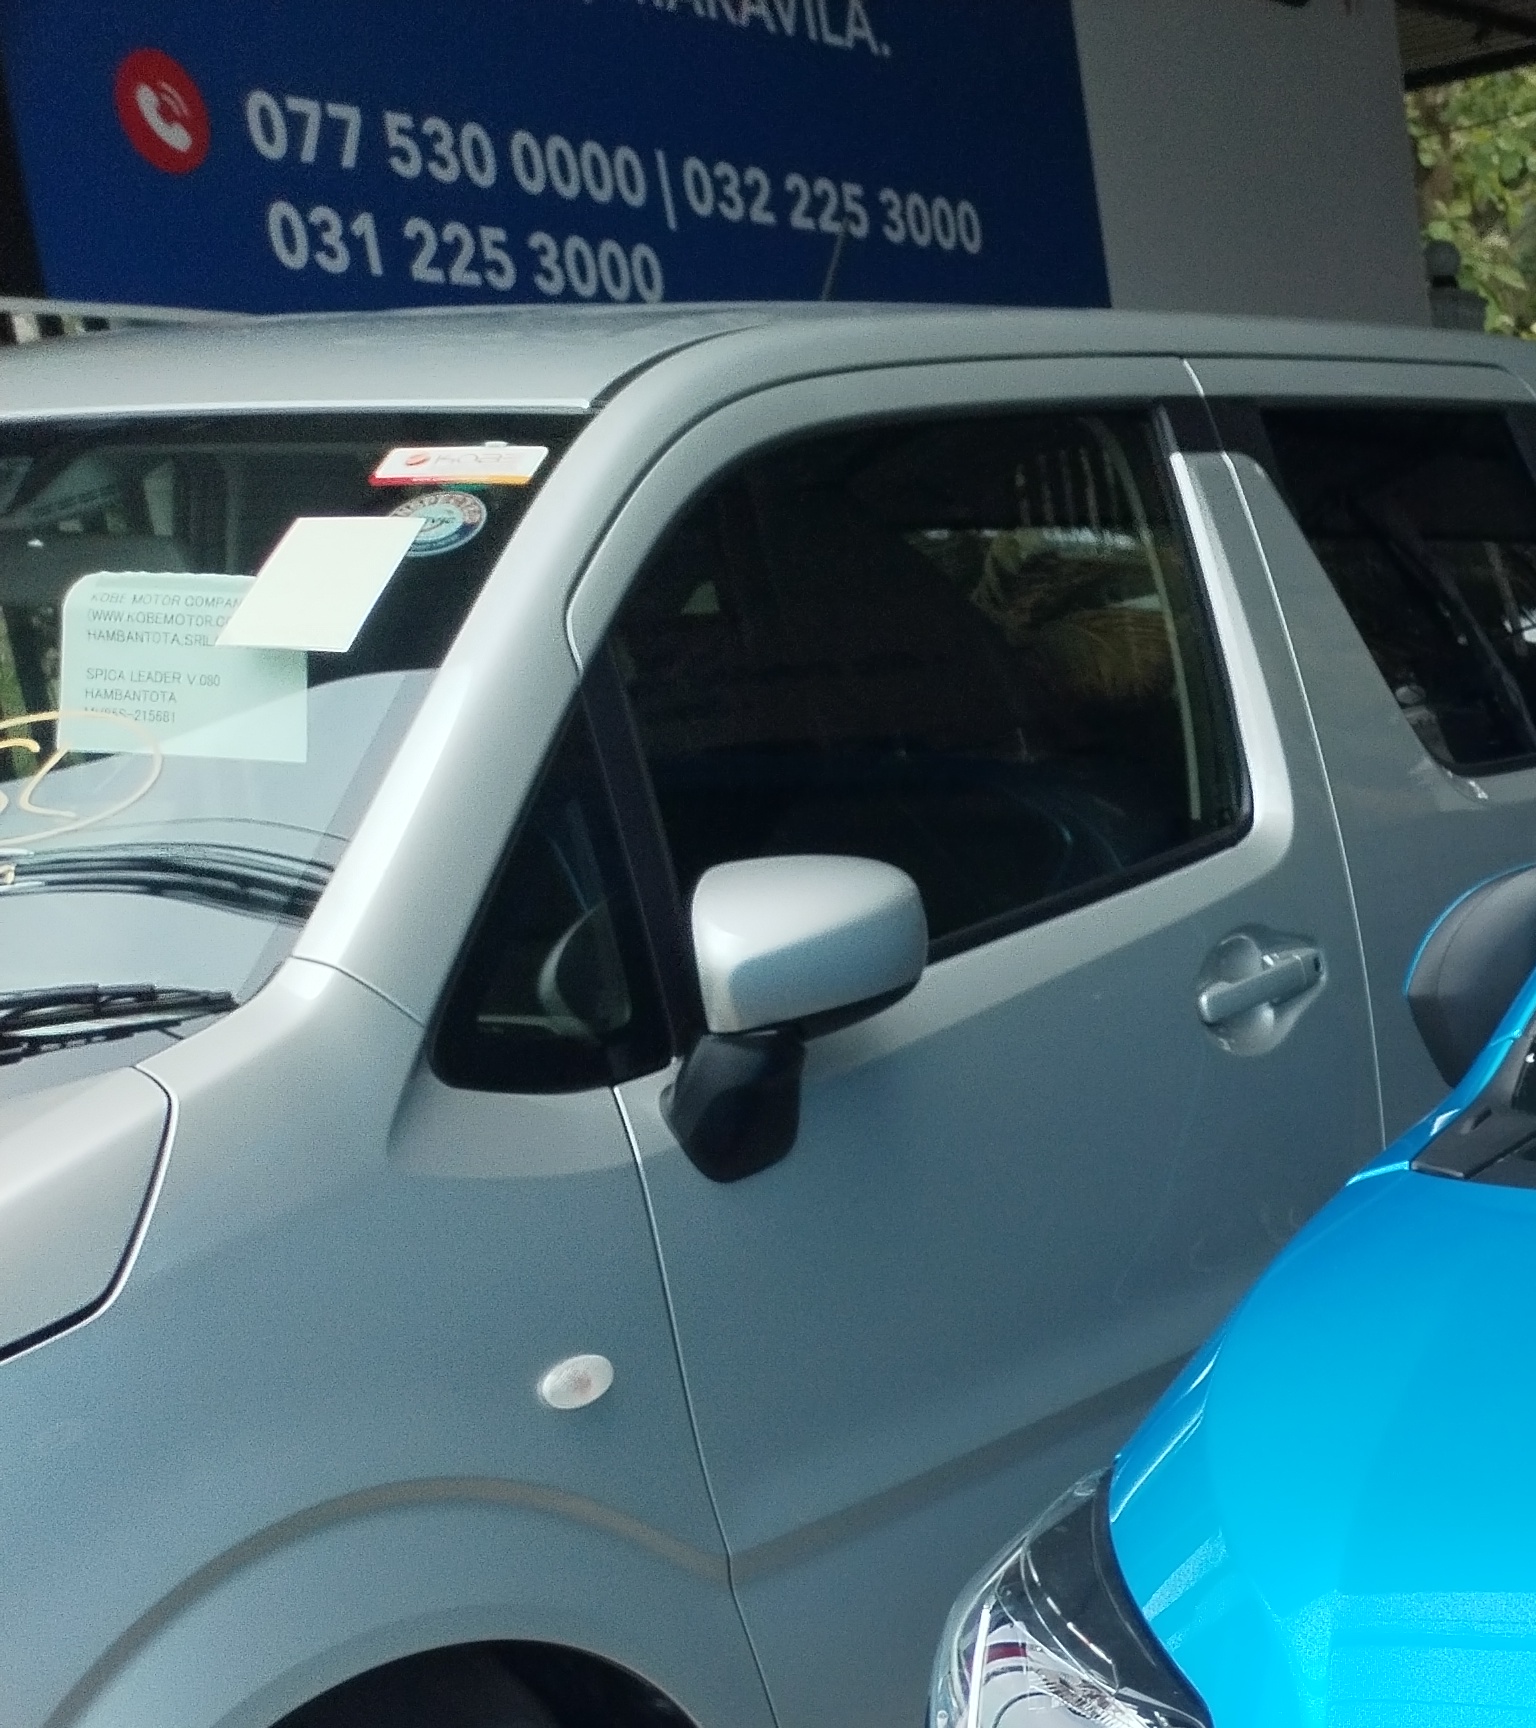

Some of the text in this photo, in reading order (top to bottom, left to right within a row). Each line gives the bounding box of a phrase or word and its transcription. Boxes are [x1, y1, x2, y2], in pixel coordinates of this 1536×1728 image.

[636, 0, 893, 57] AVILA.
[243, 89, 361, 170] 077
[383, 110, 496, 188] 530
[509, 130, 646, 208] 0000
[682, 156, 778, 227] 032
[784, 172, 869, 238] 225
[878, 188, 982, 254] 3000
[266, 200, 665, 304] 031 225 3000
[91, 592, 241, 608] KOBE MOTOR COMPA
[86, 667, 126, 682] SPICA
[131, 670, 182, 684] LEADER
[85, 688, 177, 704] HAMBANTOTA
